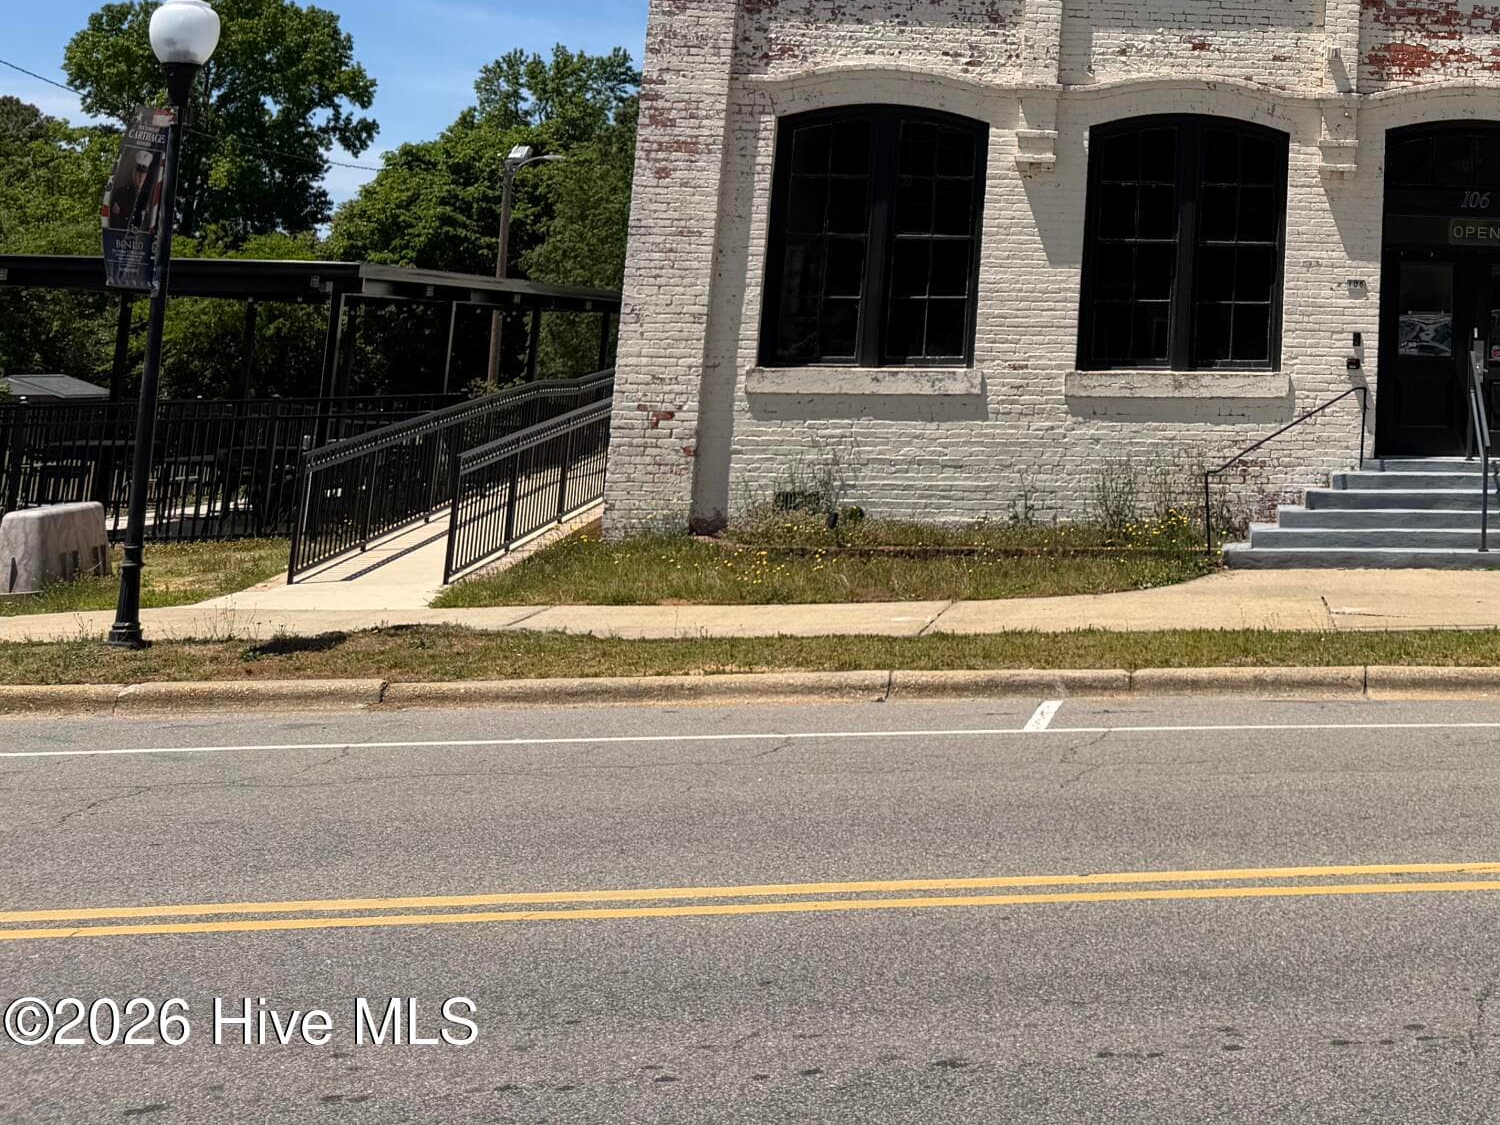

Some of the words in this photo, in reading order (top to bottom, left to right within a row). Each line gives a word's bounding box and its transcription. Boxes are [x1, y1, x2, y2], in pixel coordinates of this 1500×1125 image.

[128, 129, 166, 144] CARTHAGE
[1460, 191, 1491, 209] 106
[1452, 225, 1500, 240] OPEN
